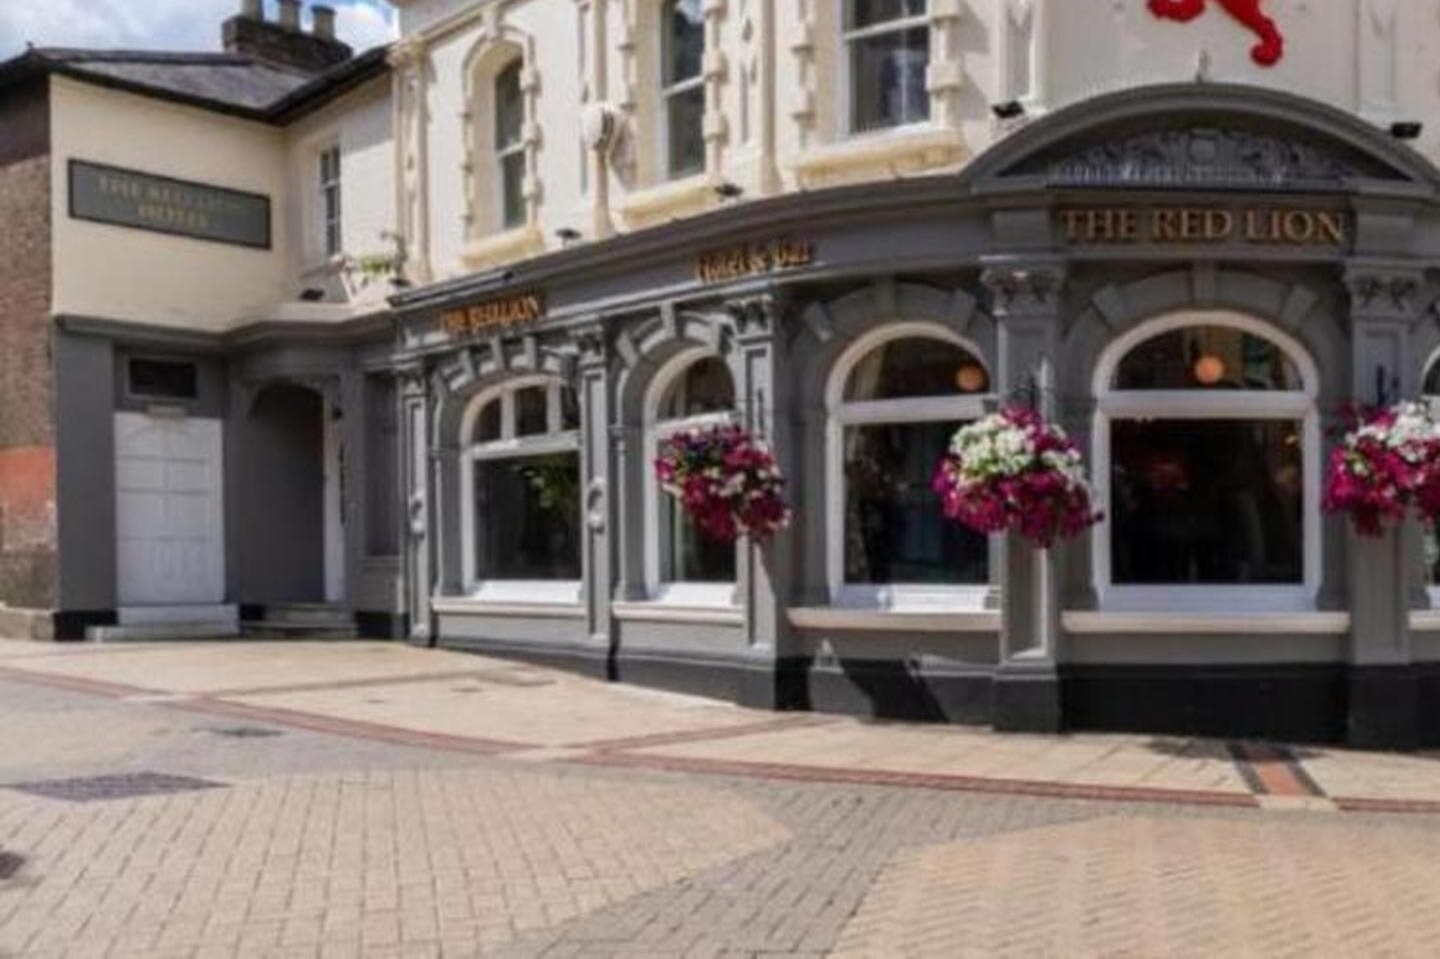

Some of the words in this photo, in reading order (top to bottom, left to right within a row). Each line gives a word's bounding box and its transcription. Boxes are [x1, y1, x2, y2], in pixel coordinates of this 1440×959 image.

[1060, 209, 1137, 239] THE
[1152, 209, 1233, 240] RED
[1246, 209, 1346, 240] LION
